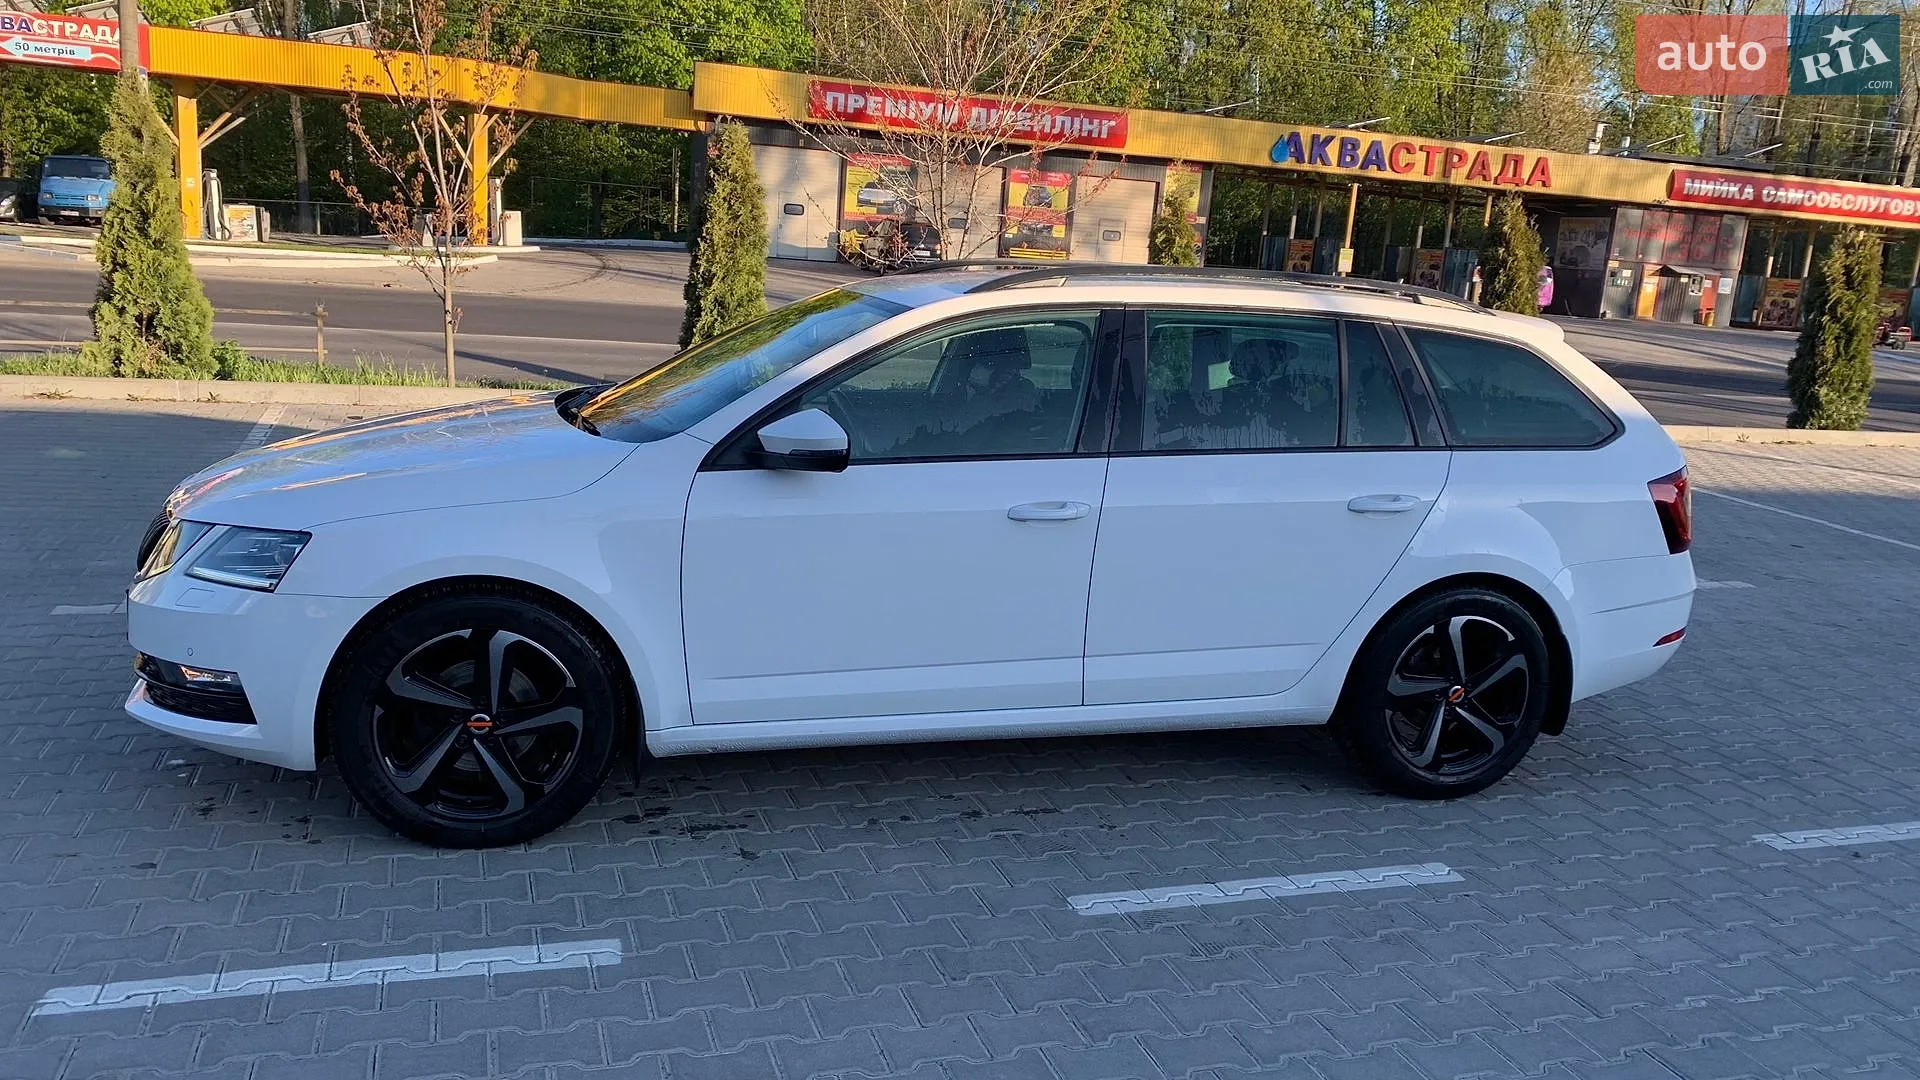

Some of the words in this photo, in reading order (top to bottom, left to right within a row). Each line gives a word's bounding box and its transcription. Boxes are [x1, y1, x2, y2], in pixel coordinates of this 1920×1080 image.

[15, 42, 30, 52] 50
[34, 45, 76, 56] метрів
[826, 91, 960, 125] ПРЕМІУМ
[1286, 131, 1552, 188] АКВАСТРАДА
[1683, 176, 1755, 201] МИЙКА
